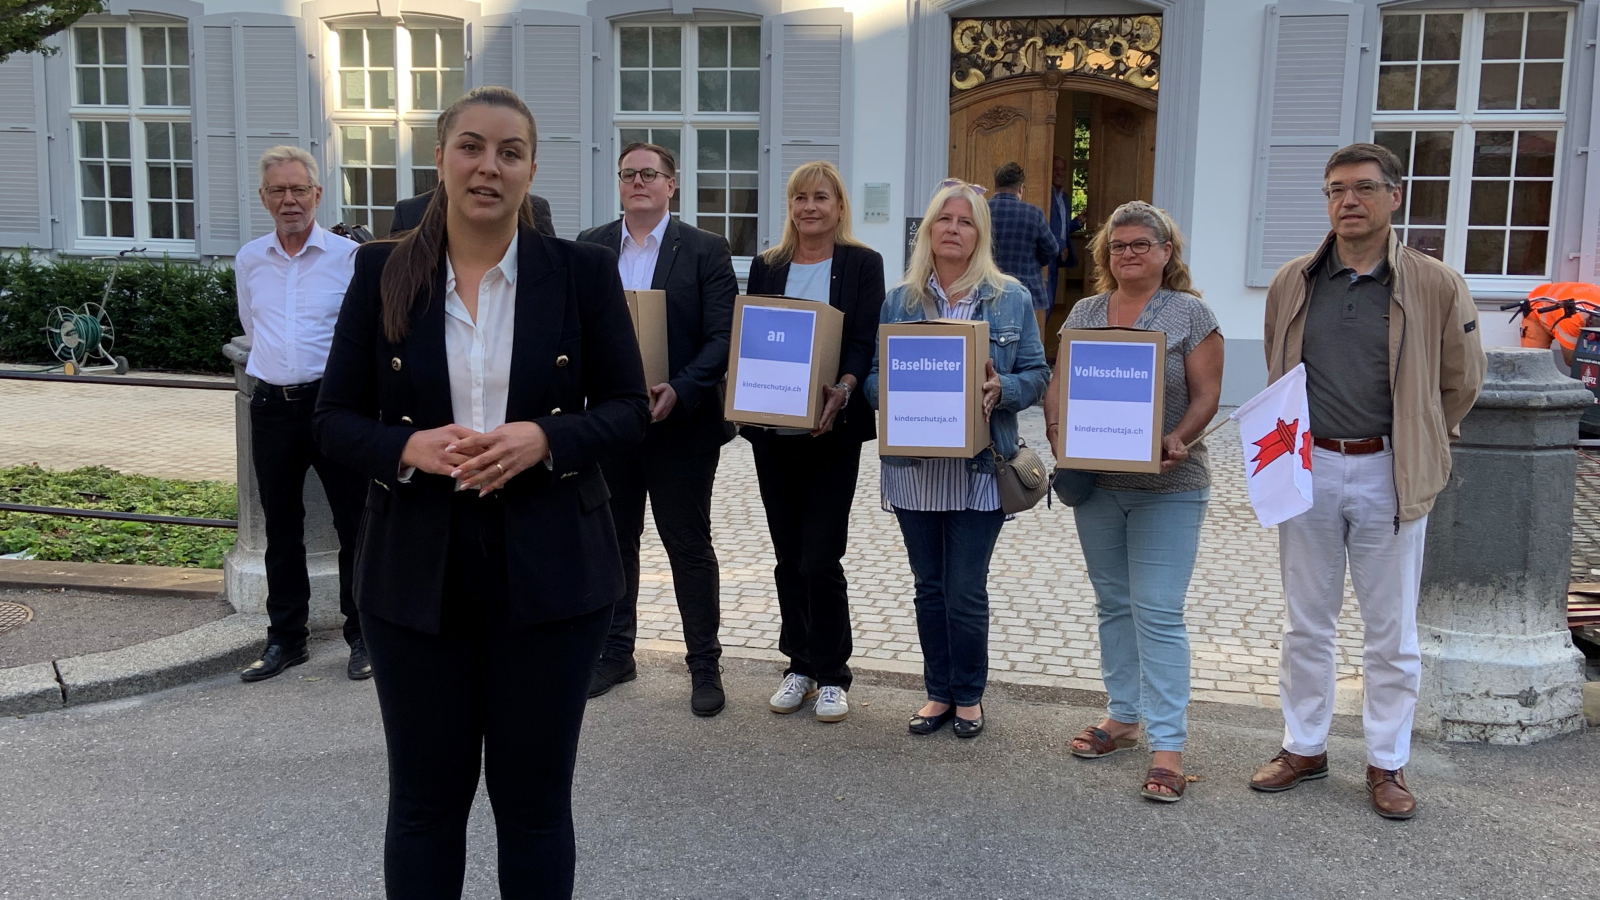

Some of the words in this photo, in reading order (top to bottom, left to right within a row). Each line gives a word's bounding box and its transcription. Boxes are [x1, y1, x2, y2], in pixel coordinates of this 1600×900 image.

[767, 330, 785, 342] an
[891, 358, 961, 371] Baselbieter
[1074, 365, 1149, 379] Volksschulen
[742, 381, 802, 392] kinderschutzja.ch
[894, 415, 958, 423] kinderschutzja.ch
[1074, 425, 1144, 435] kinderschutzja.ch
